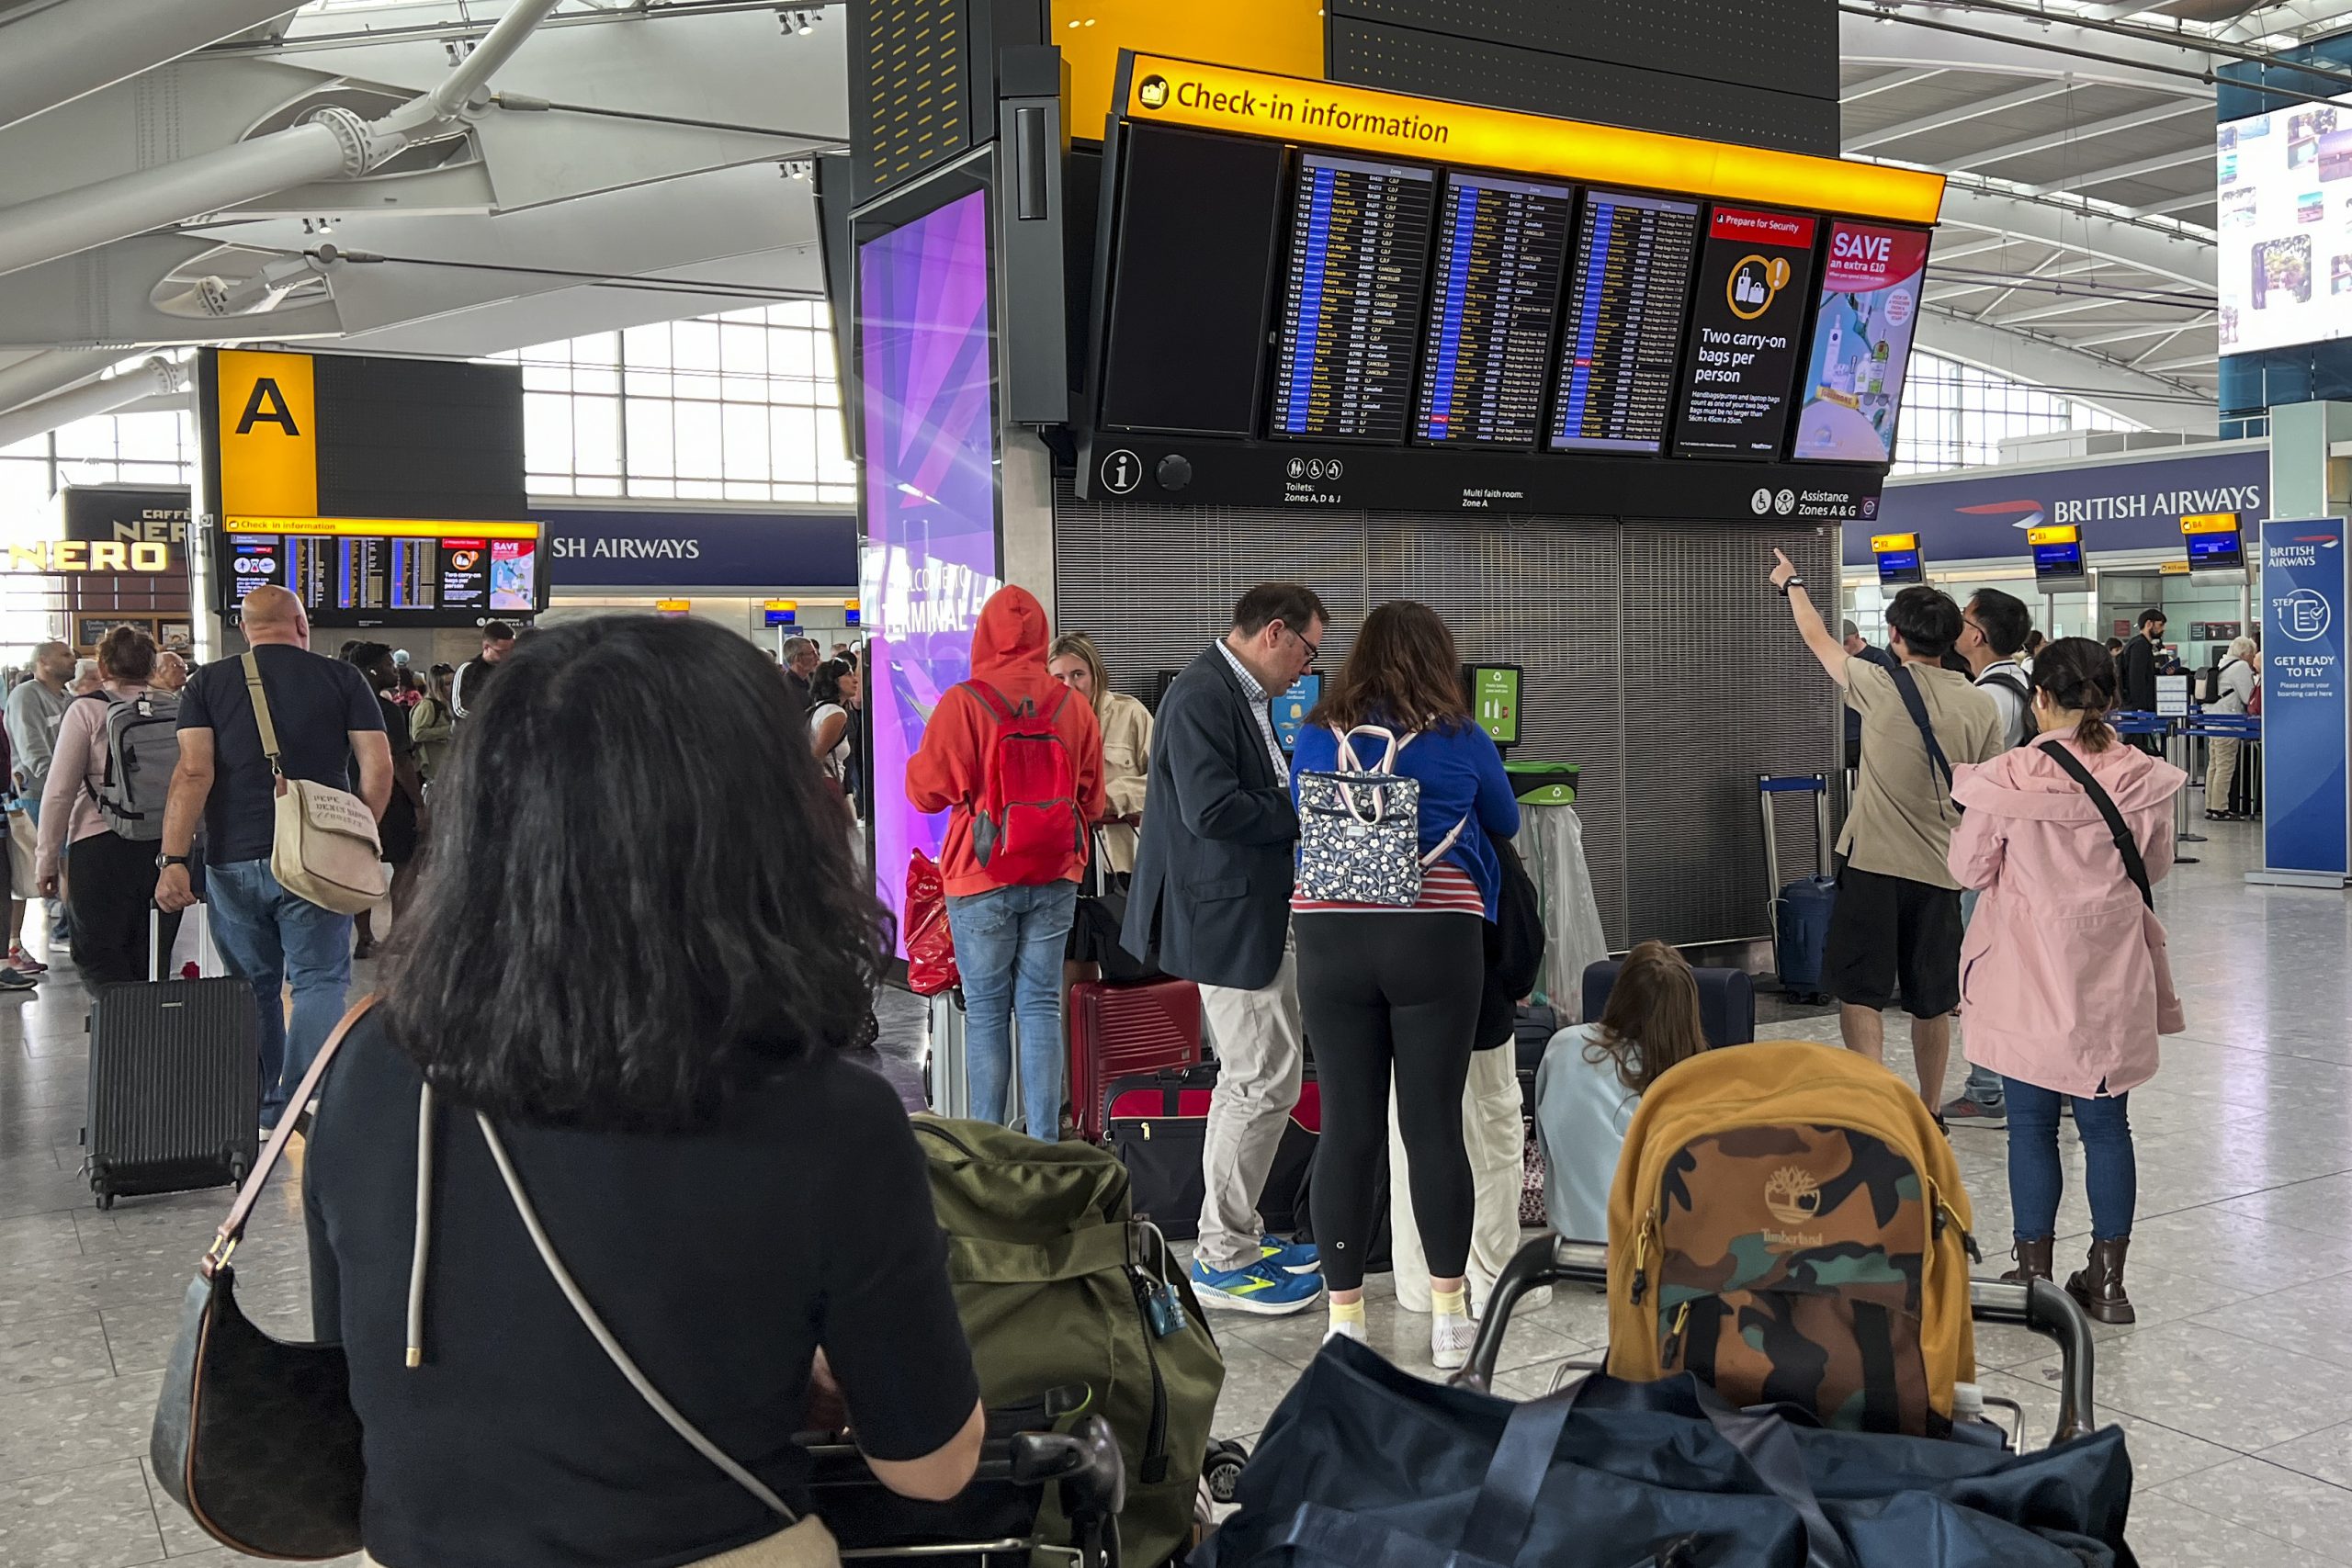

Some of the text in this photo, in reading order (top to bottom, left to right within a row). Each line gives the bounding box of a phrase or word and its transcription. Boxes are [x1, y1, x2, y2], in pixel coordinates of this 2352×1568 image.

[1177, 82, 1448, 143] Check-in information
[1725, 215, 1799, 233] Prepare for Security
[1834, 232, 1892, 262] SAVE
[1830, 260, 1885, 273] an extra £10
[1702, 328, 1787, 350] Two carry-on
[1699, 347, 1755, 367] bags per
[1695, 369, 1741, 384] person
[1691, 390, 1737, 400] Handbags/purses
[1767, 395, 1780, 403] bags
[235, 377, 300, 436] A
[1734, 410, 1749, 418] larger
[1286, 482, 1315, 492] Toilets:
[1284, 492, 1341, 503] Zones A, D & J
[1463, 489, 1523, 499] Multi faith room:
[1800, 490, 1849, 502] Assistance
[1462, 499, 1481, 507] Zone
[2054, 485, 2260, 524] BRITISH AIRWAYS
[1798, 504, 1856, 516] Zones A & G
[113, 520, 187, 543] NER
[283, 521, 336, 530] information
[493, 541, 519, 551] SAVE
[593, 538, 700, 559] AIRWAYS
[2269, 546, 2314, 558] BRITISH
[8, 540, 168, 571] NERO
[2267, 556, 2315, 568] AIRWAYS
[2272, 598, 2294, 607] STEP
[882, 597, 968, 634] TERMINAL
[2277, 606, 2282, 620] 1
[2274, 656, 2335, 666] GET READY
[2286, 667, 2324, 677] TO FLY
[1761, 1227, 1823, 1246] Timberland
